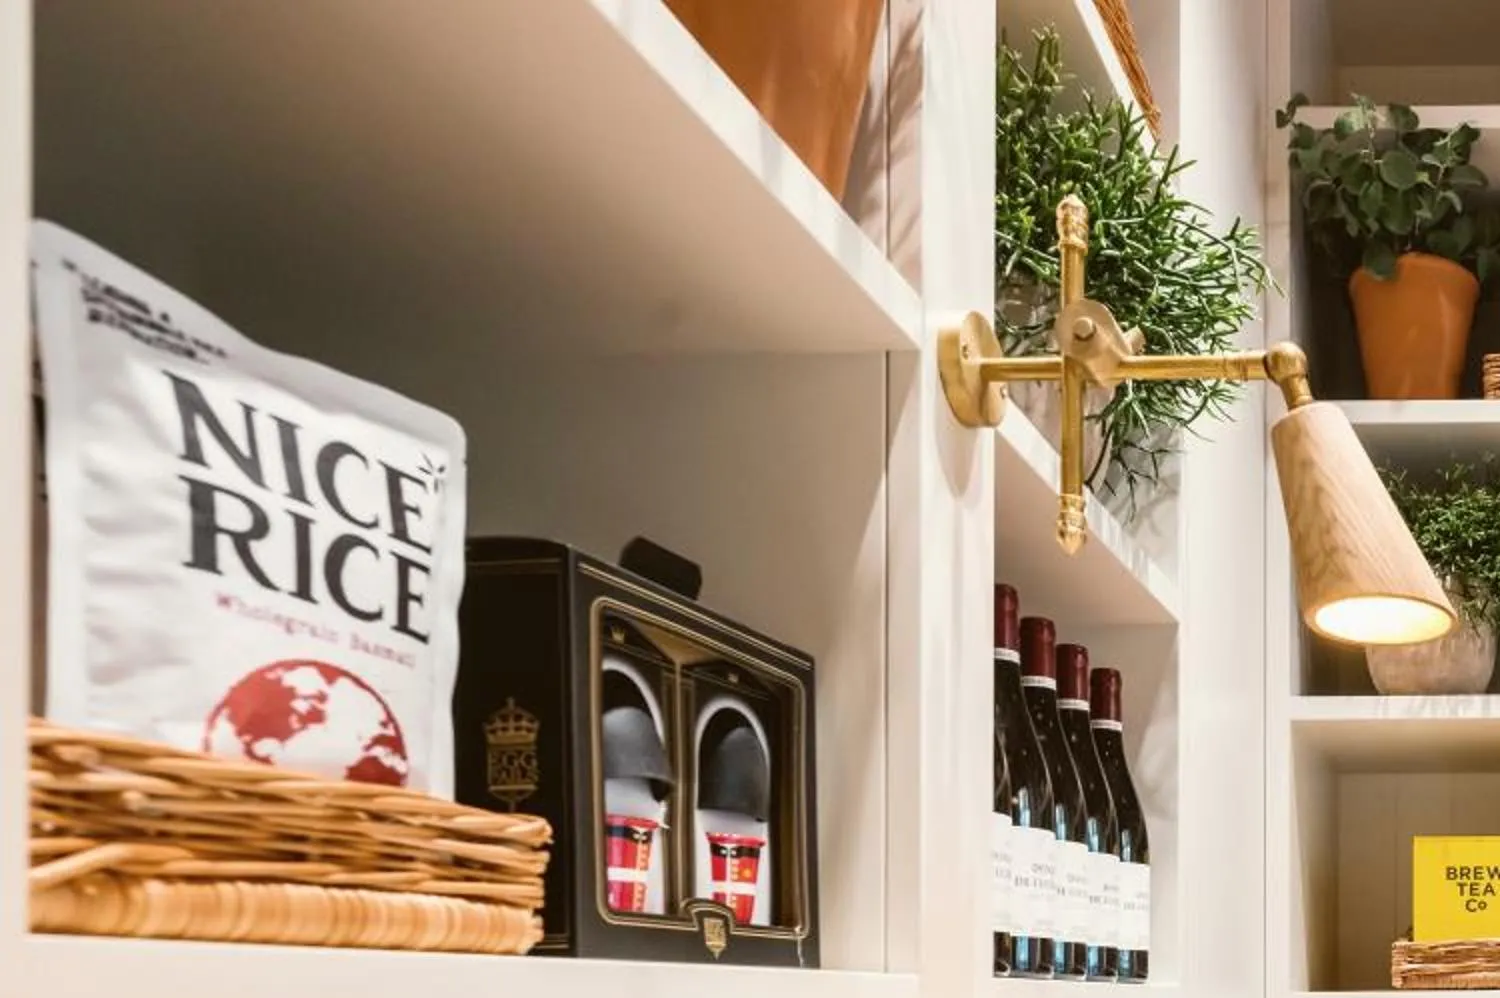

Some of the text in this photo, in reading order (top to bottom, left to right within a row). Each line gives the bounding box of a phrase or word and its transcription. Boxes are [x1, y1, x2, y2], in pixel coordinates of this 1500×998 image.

[162, 368, 432, 556] NICE
[177, 474, 432, 646] RICE
[1457, 882, 1496, 897] TEA
[1465, 899, 1488, 912] Co
